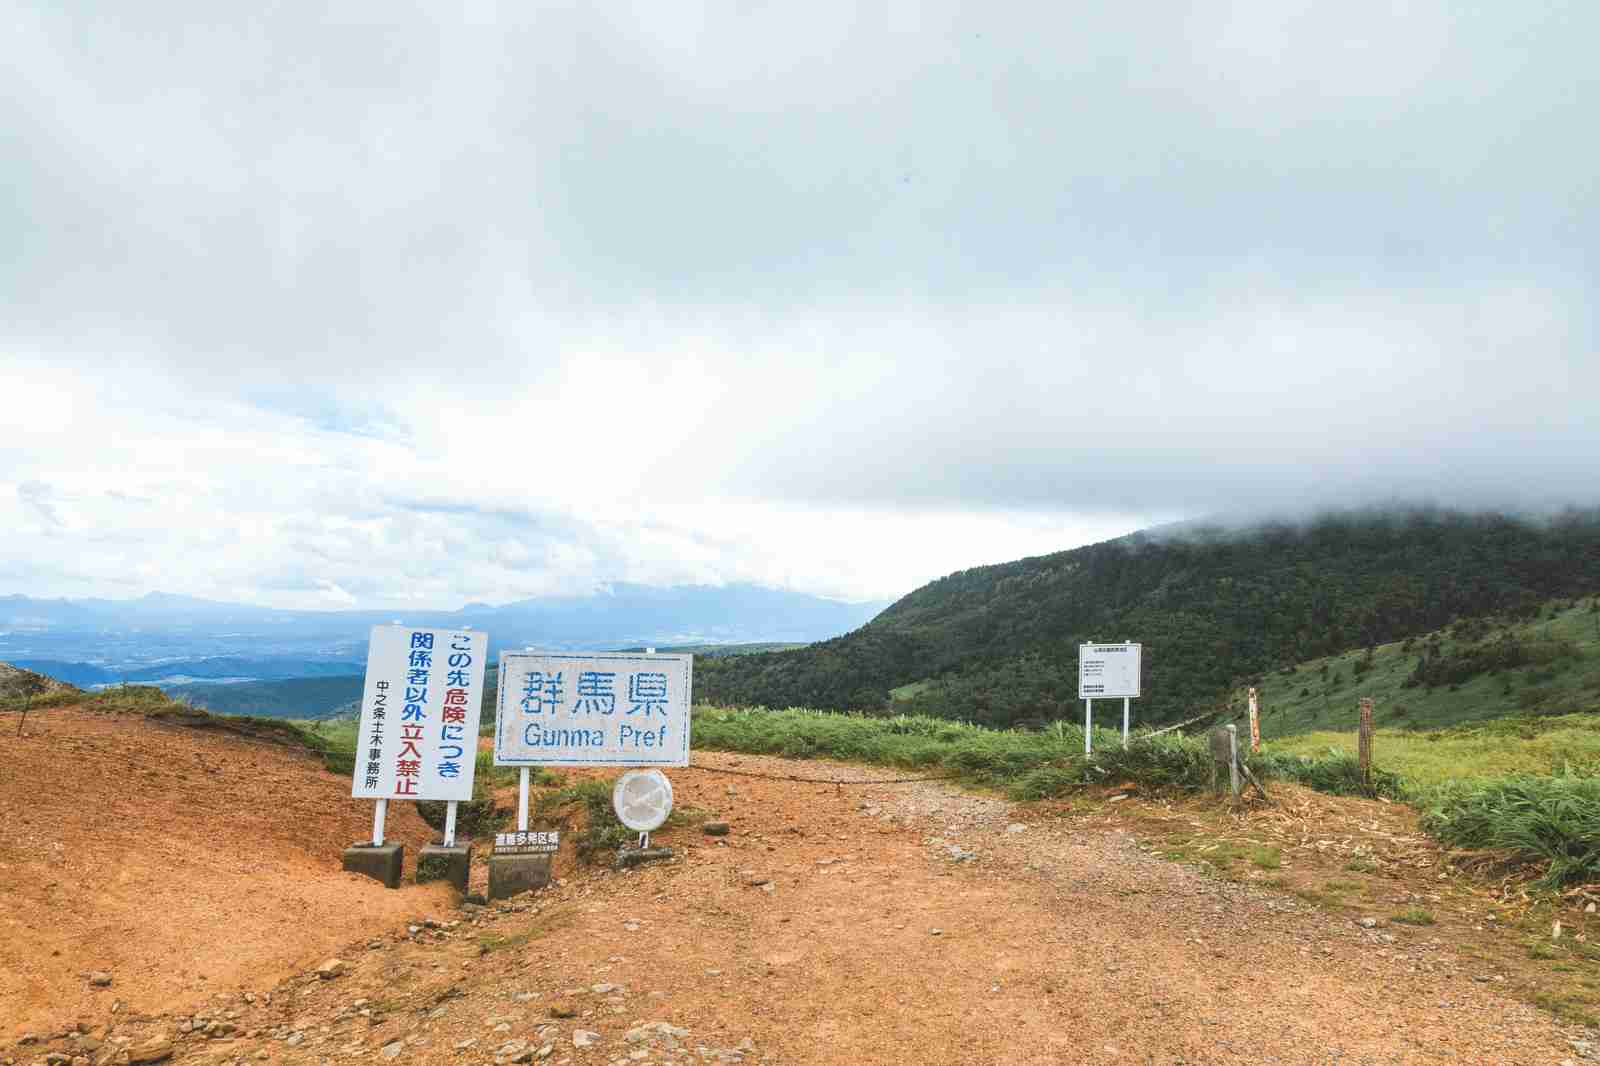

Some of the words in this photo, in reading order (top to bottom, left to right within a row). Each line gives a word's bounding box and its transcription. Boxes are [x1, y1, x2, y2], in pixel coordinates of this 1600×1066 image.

[365, 680, 389, 789] 中之条土木事務所
[395, 631, 434, 795] 関係者以外立入禁止
[438, 634, 472, 778] この先危険につき
[521, 671, 669, 716] 群馬県
[525, 723, 603, 747] Gunma
[620, 725, 666, 747] Pref
